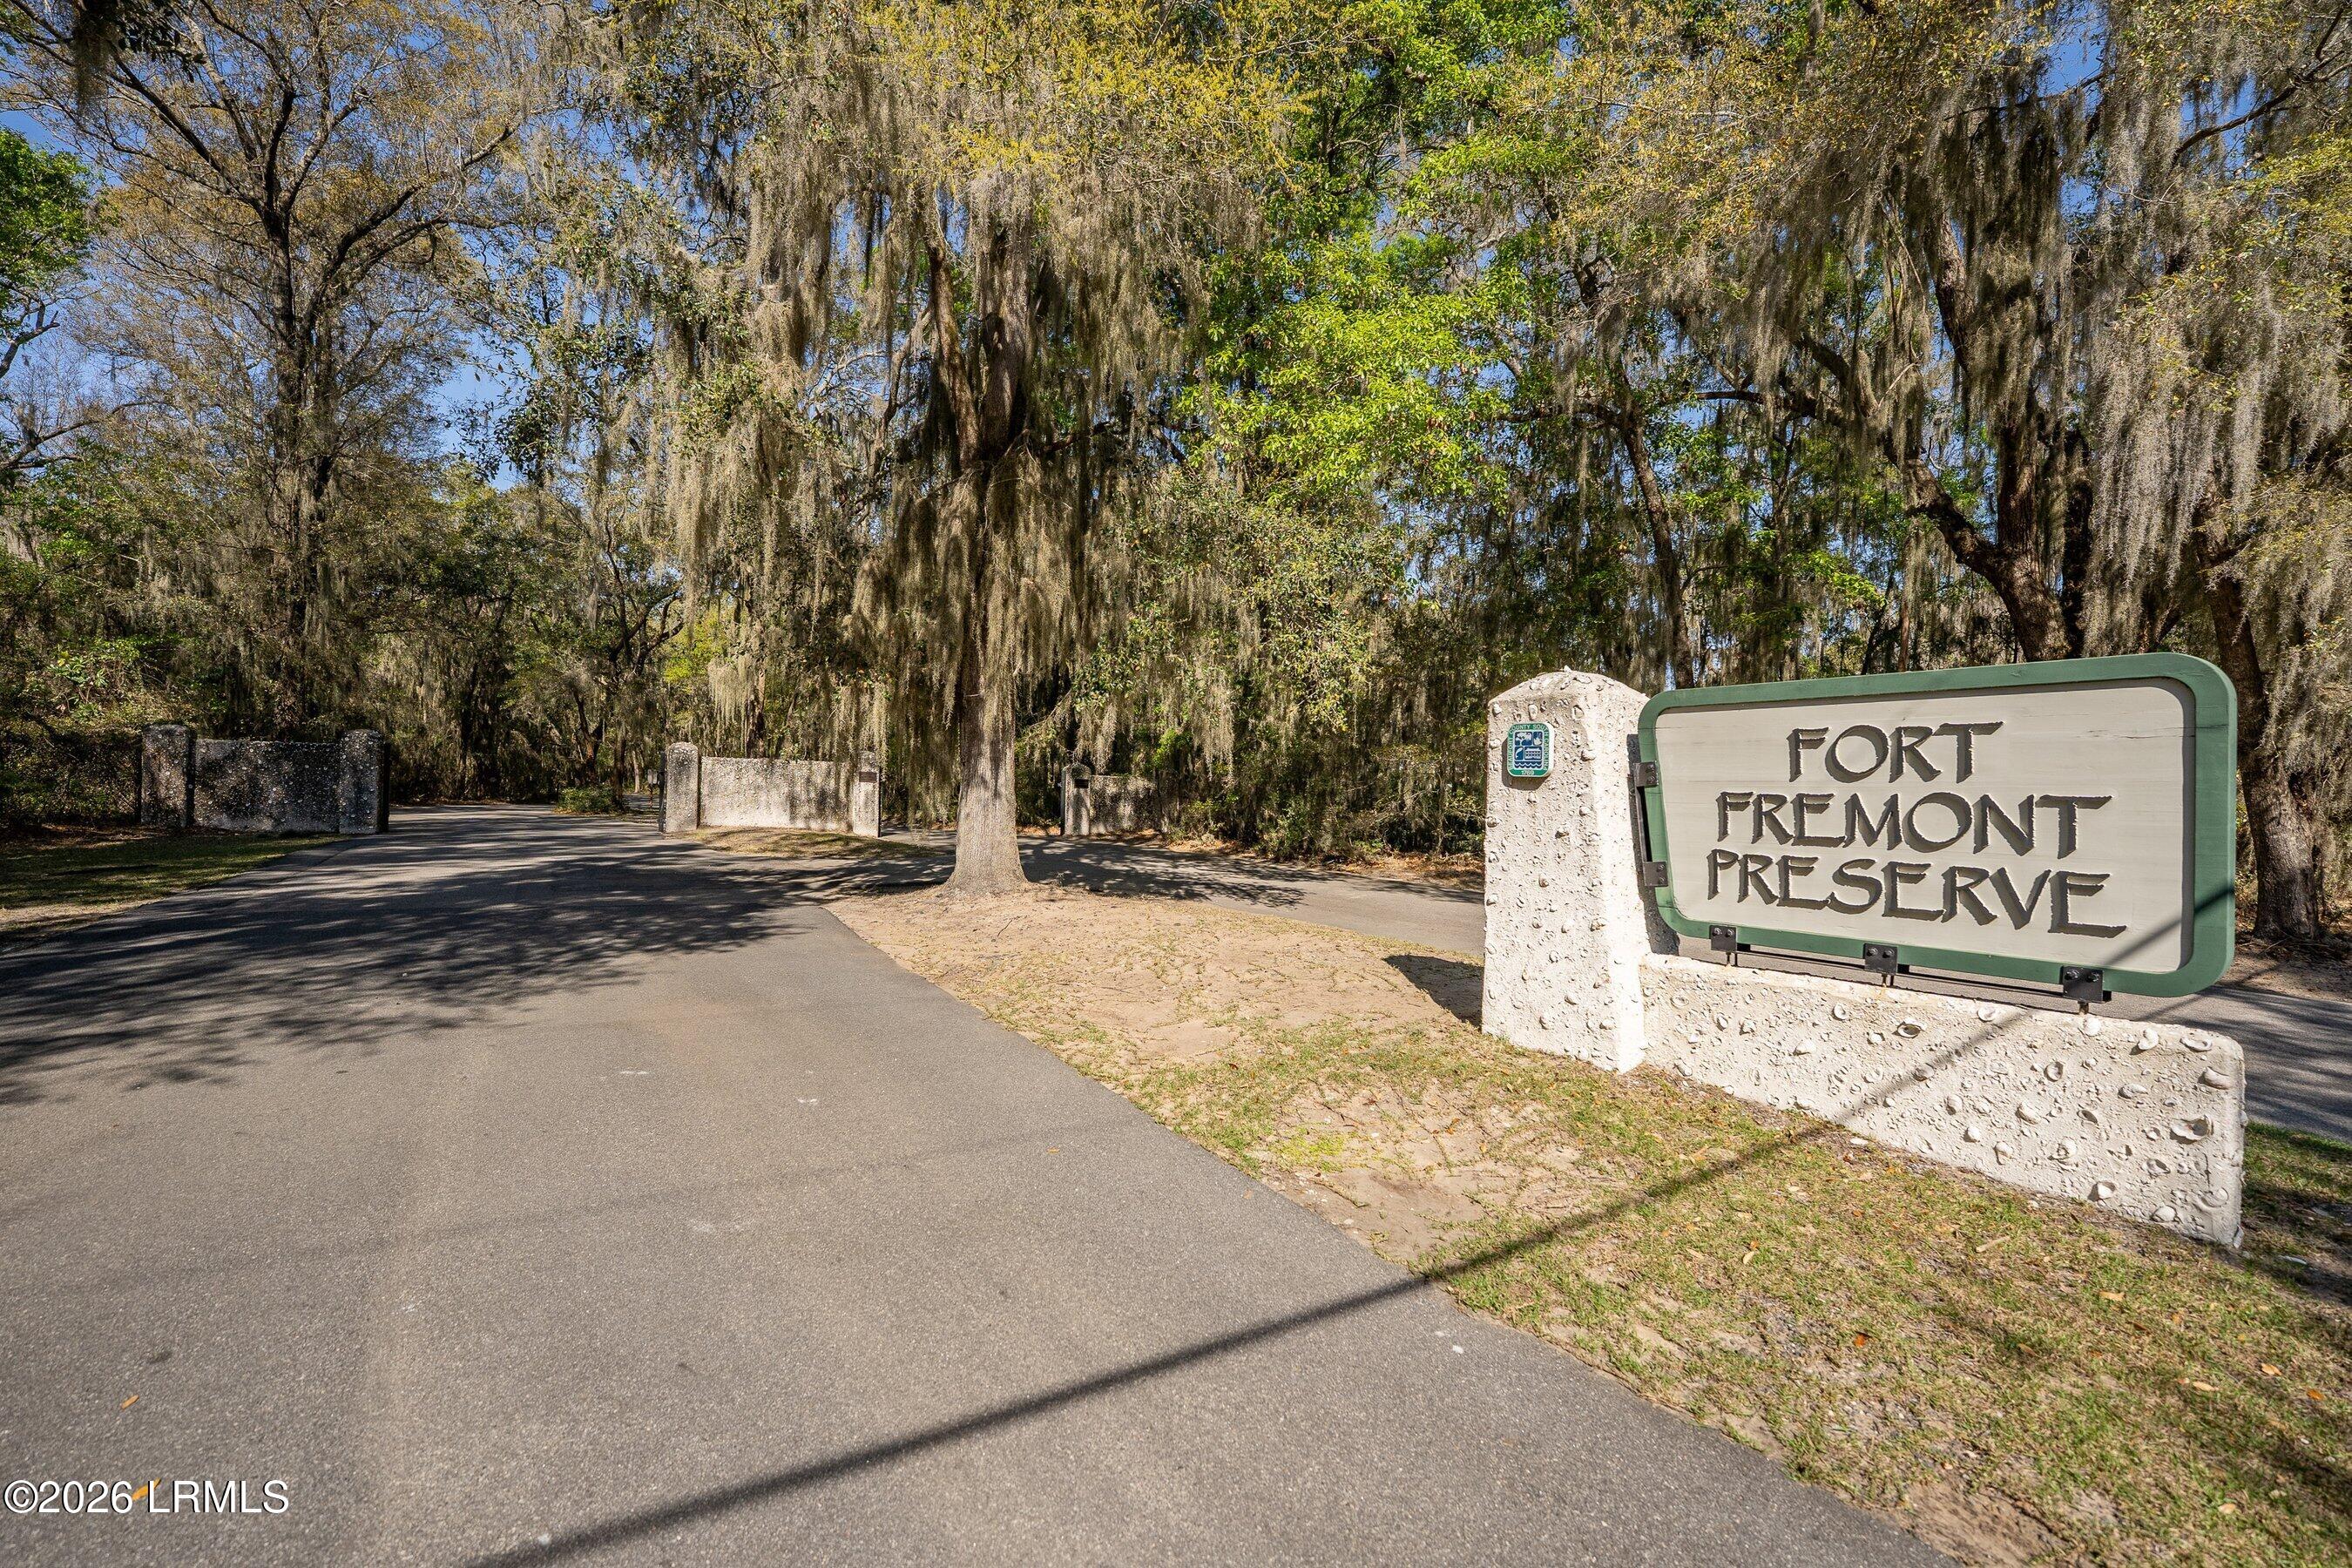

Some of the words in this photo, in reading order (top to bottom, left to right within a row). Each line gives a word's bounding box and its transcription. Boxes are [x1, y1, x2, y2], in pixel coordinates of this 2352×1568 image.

[1510, 725, 1530, 734] COUNTY
[1787, 720, 2004, 784] FORT
[1716, 791, 2112, 859] FREMONT
[1707, 849, 2126, 938] PRESERVE
